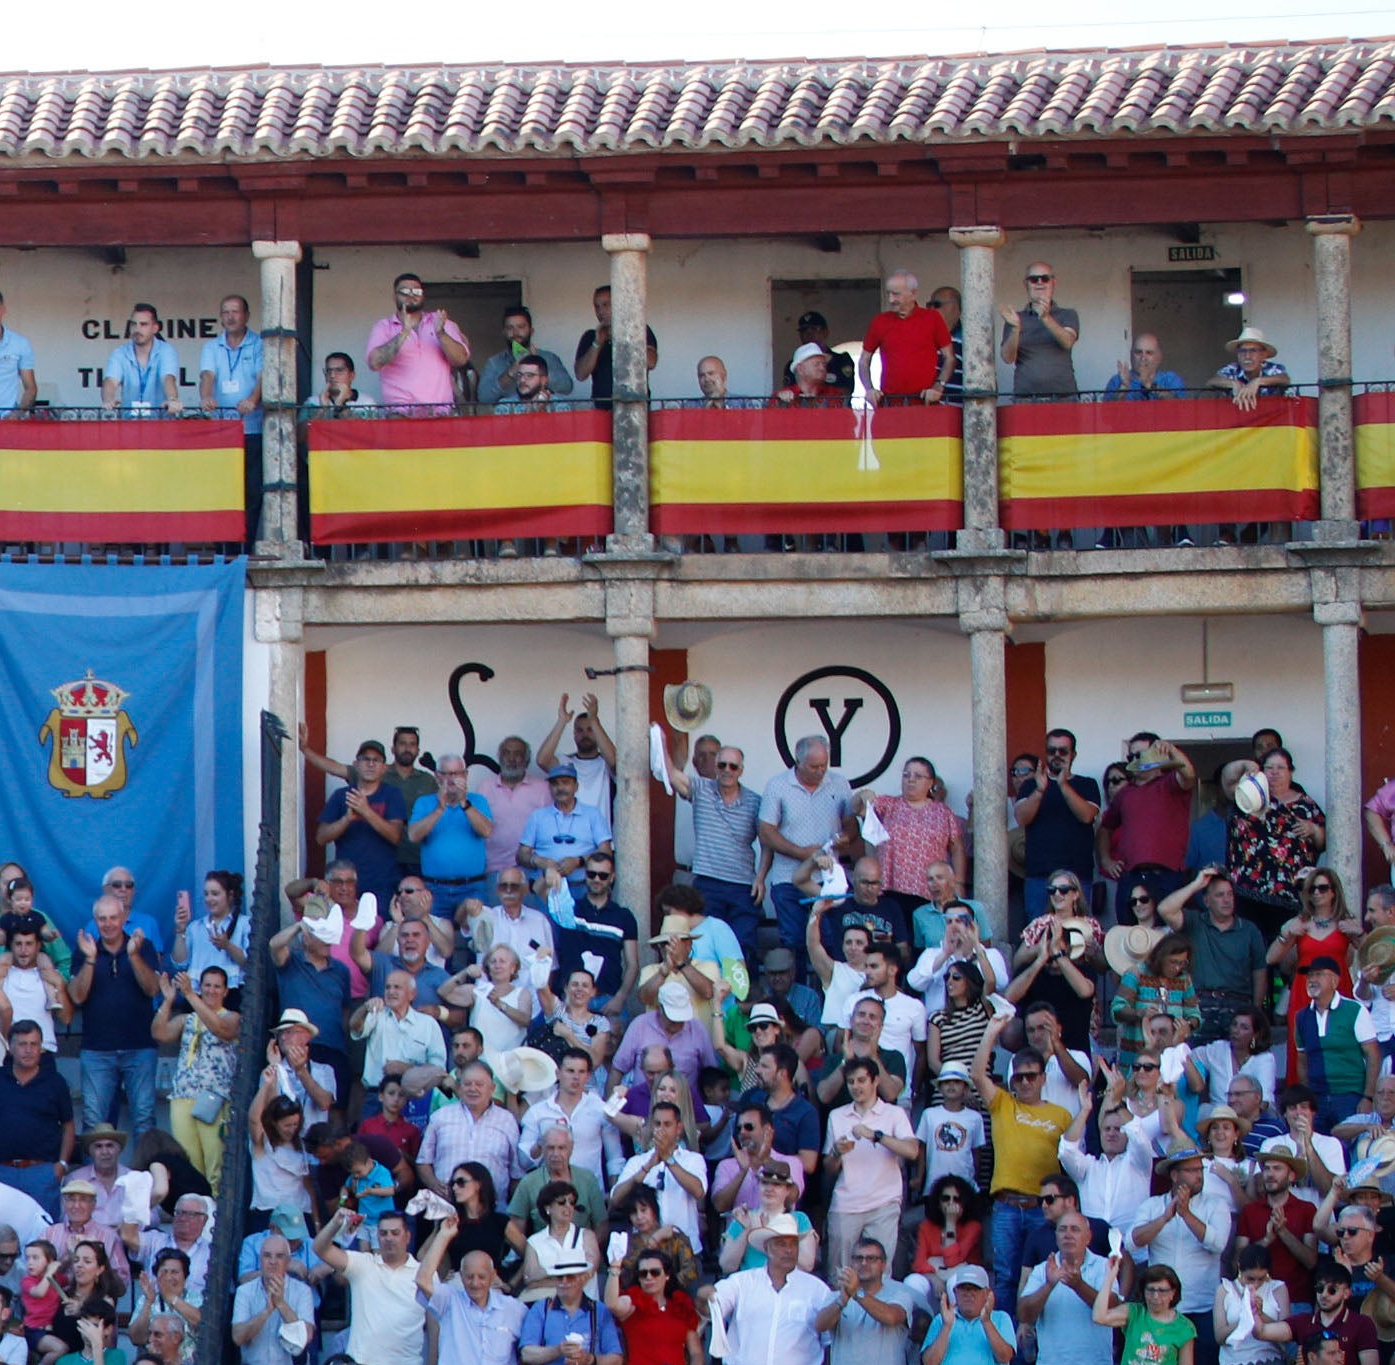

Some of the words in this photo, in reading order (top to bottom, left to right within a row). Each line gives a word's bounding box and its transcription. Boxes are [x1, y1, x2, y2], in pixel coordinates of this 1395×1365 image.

[1171, 247, 1212, 260] SALIDA
[1185, 714, 1229, 726] SALIDA
[730, 963, 747, 989] VOX
